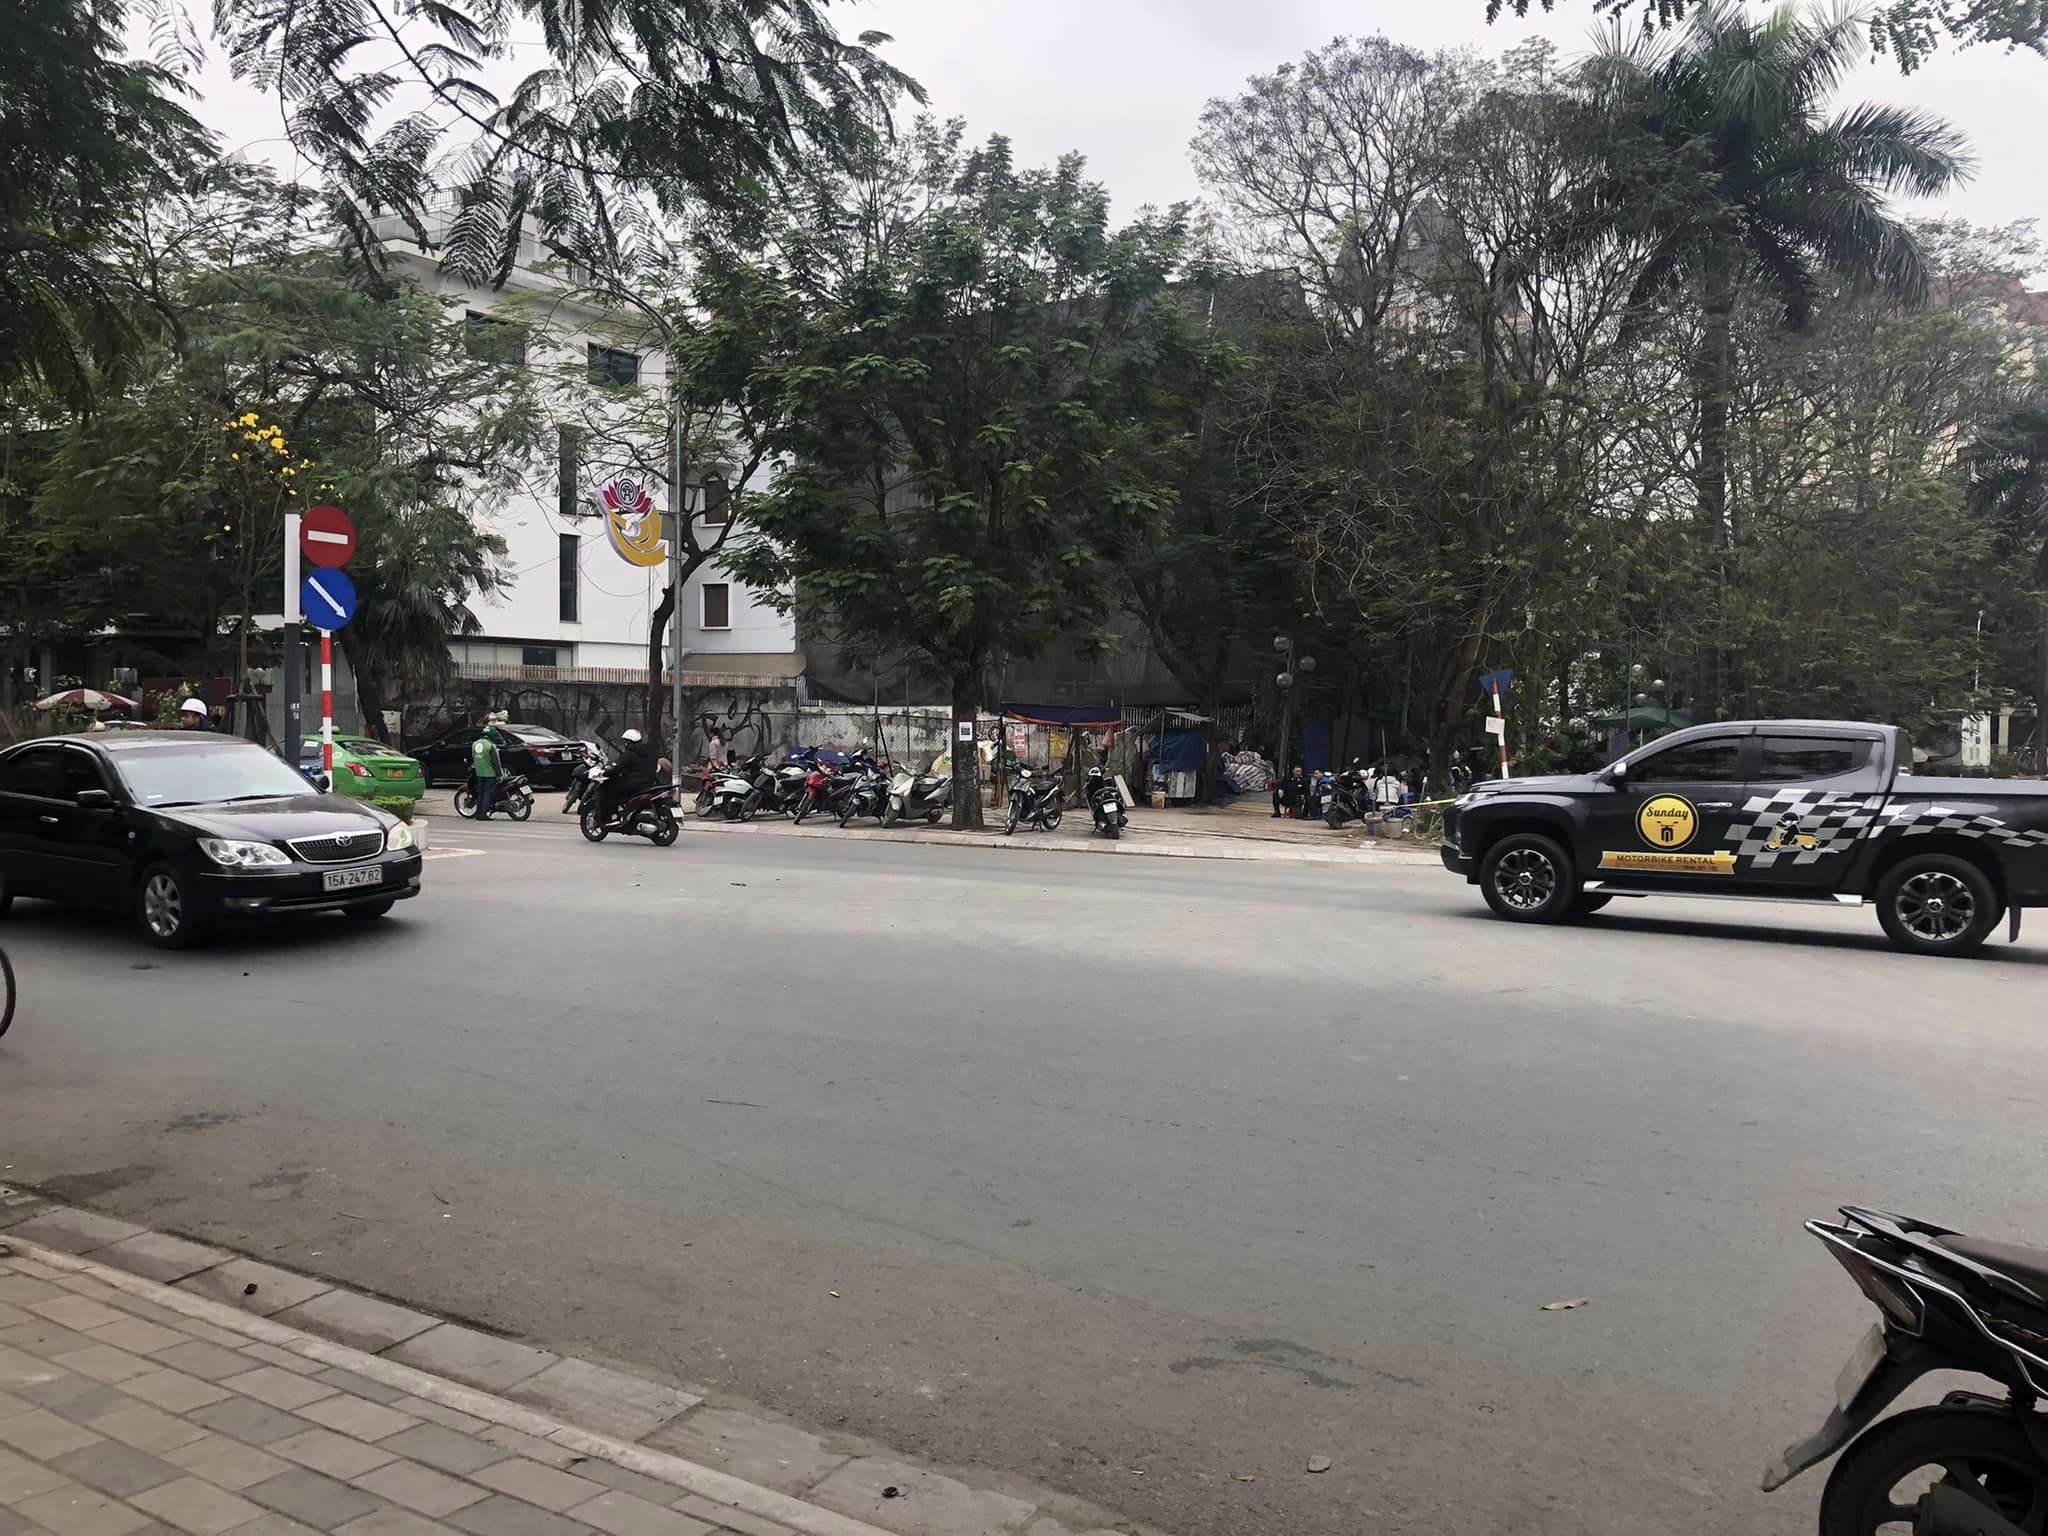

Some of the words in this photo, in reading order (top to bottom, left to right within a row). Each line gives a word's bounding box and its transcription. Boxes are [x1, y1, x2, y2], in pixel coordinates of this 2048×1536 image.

[1646, 806, 1689, 821] Sunday
[1616, 855, 1674, 864] MOTORBIKE
[1676, 857, 1716, 865] RENTAL
